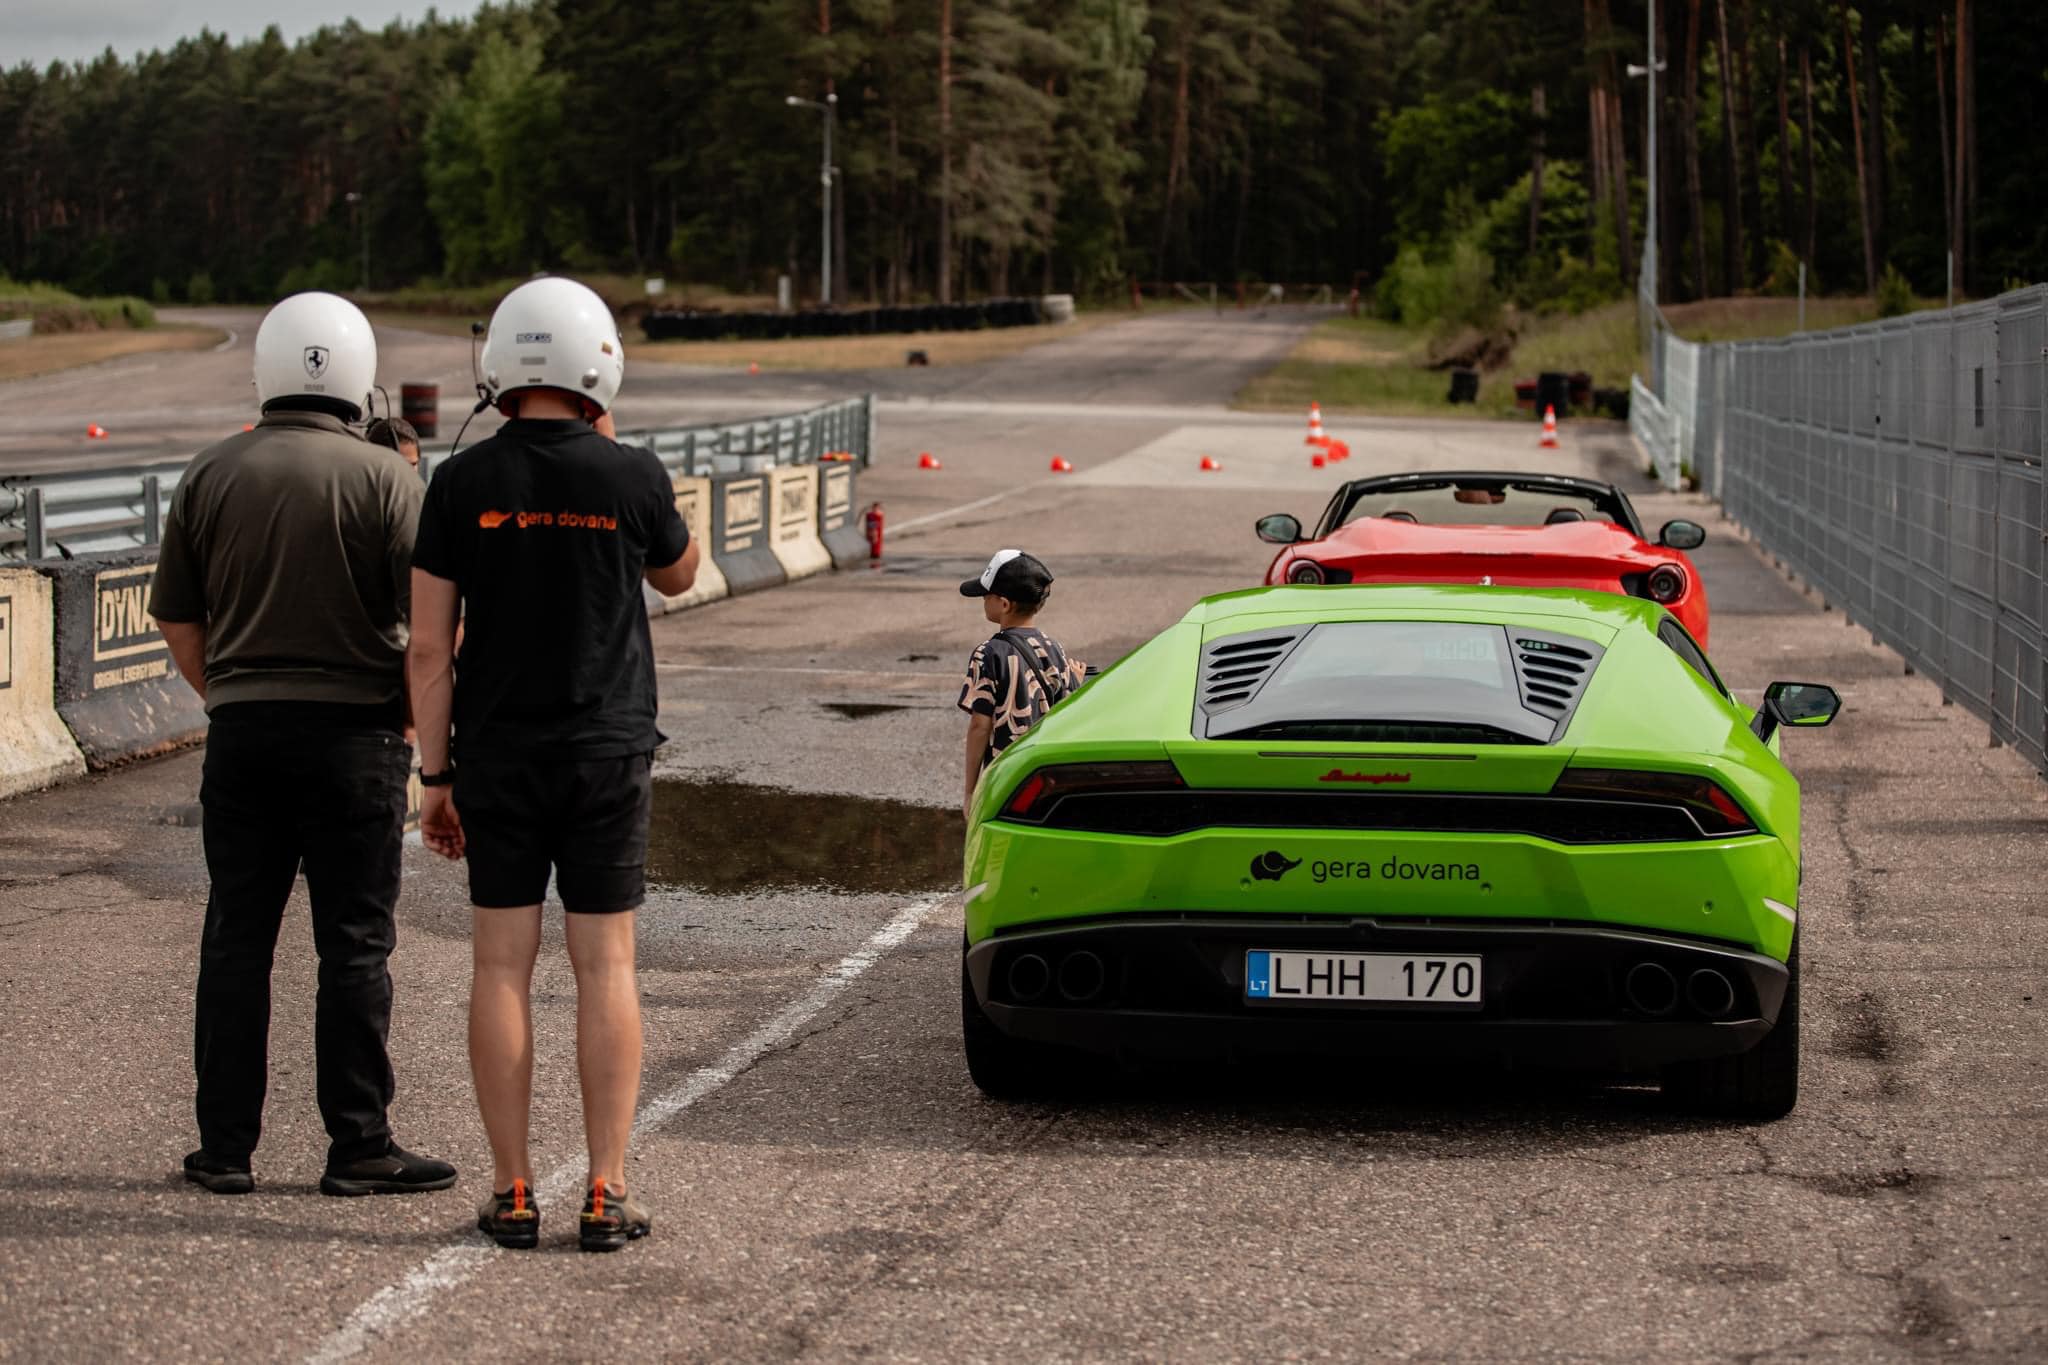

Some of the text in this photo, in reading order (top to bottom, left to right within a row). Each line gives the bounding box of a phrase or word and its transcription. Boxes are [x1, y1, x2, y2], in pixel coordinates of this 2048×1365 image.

[517, 511, 616, 530] gera dovana
[1312, 856, 1480, 883] gera dovana
[1250, 958, 1474, 997] LT LHH 170
